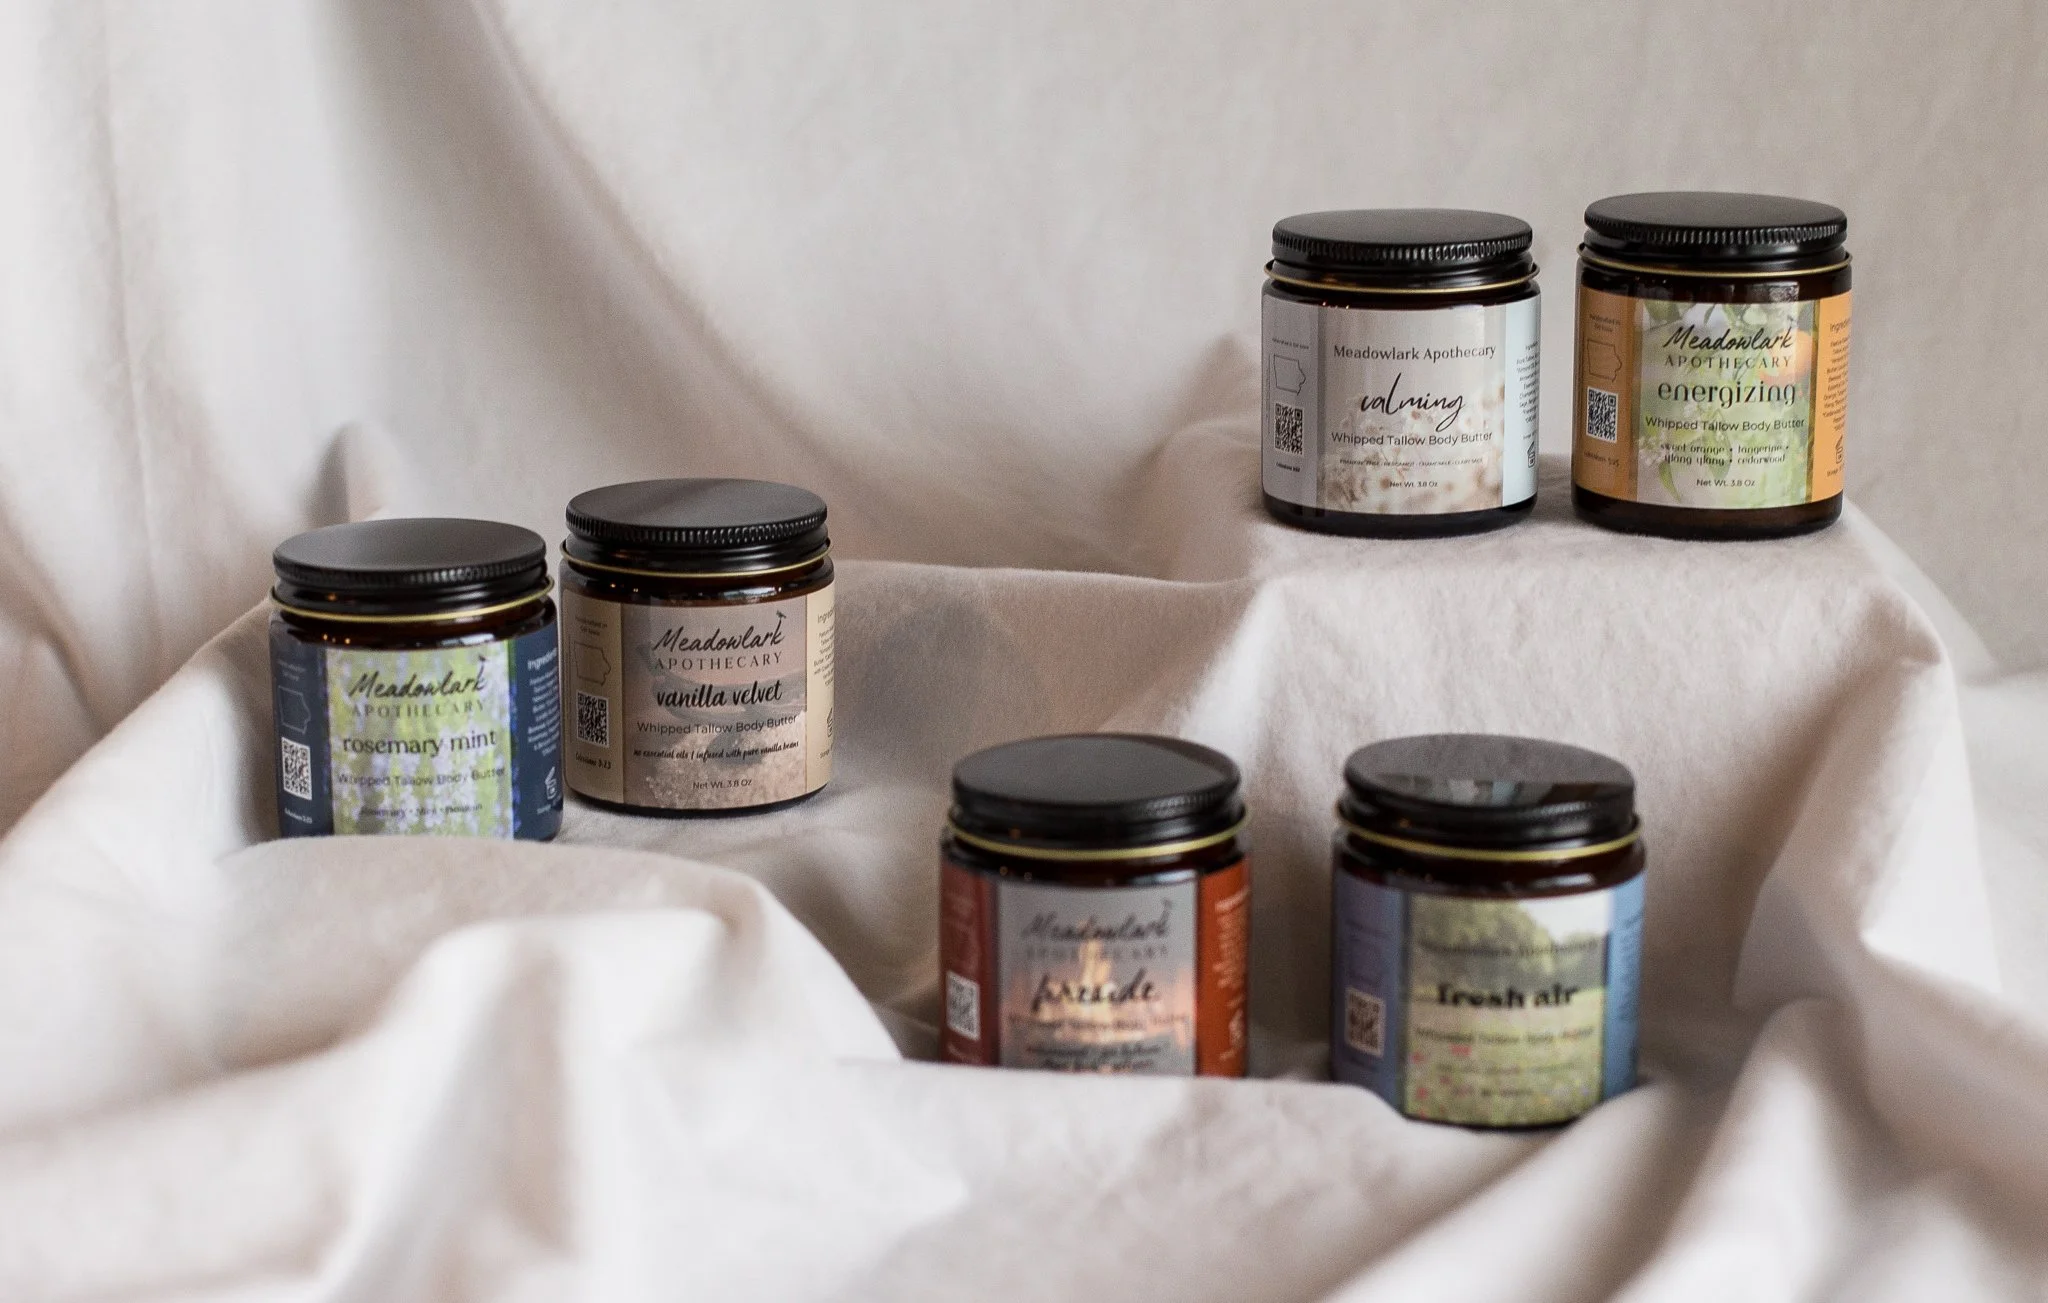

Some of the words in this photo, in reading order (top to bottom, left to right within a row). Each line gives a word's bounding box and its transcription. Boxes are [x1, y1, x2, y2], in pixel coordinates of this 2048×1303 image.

[1663, 323, 1795, 350] Meadowlark
[1333, 345, 1419, 361] Meadowlark
[1423, 345, 1497, 363] Apothecary
[1664, 353, 1792, 369] APOTHECARY
[1360, 372, 1465, 433] calming
[1657, 379, 1797, 409] energizing
[1645, 416, 1698, 431] Whipped
[1702, 420, 1740, 432] Tallow
[1742, 420, 1771, 432] Body
[1773, 418, 1805, 429] Butter
[1331, 432, 1384, 446] Whipped
[1387, 435, 1425, 446] Tallow
[1428, 435, 1459, 447] Body
[1461, 432, 1493, 443] Butter
[1389, 480, 1402, 488] Net
[1696, 478, 1711, 487] Net
[653, 618, 786, 652] Meadowlark
[654, 651, 783, 671] APOTHECARY
[348, 663, 487, 699] Meadowlark
[656, 683, 727, 708] vanilla
[732, 678, 783, 705] velvet
[637, 721, 691, 736] Whipped
[695, 723, 733, 735] Tallow
[735, 721, 765, 733] Body
[766, 714, 797, 729] Butter
[342, 735, 444, 757] rosemary
[450, 730, 497, 751] mint
[643, 749, 674, 760] essential
[696, 749, 724, 763] infused
[725, 748, 742, 758] with
[760, 742, 782, 755] vanilla
[692, 781, 708, 790] Net
[1437, 982, 1525, 1009] fresh
[1533, 981, 1580, 1007] air
